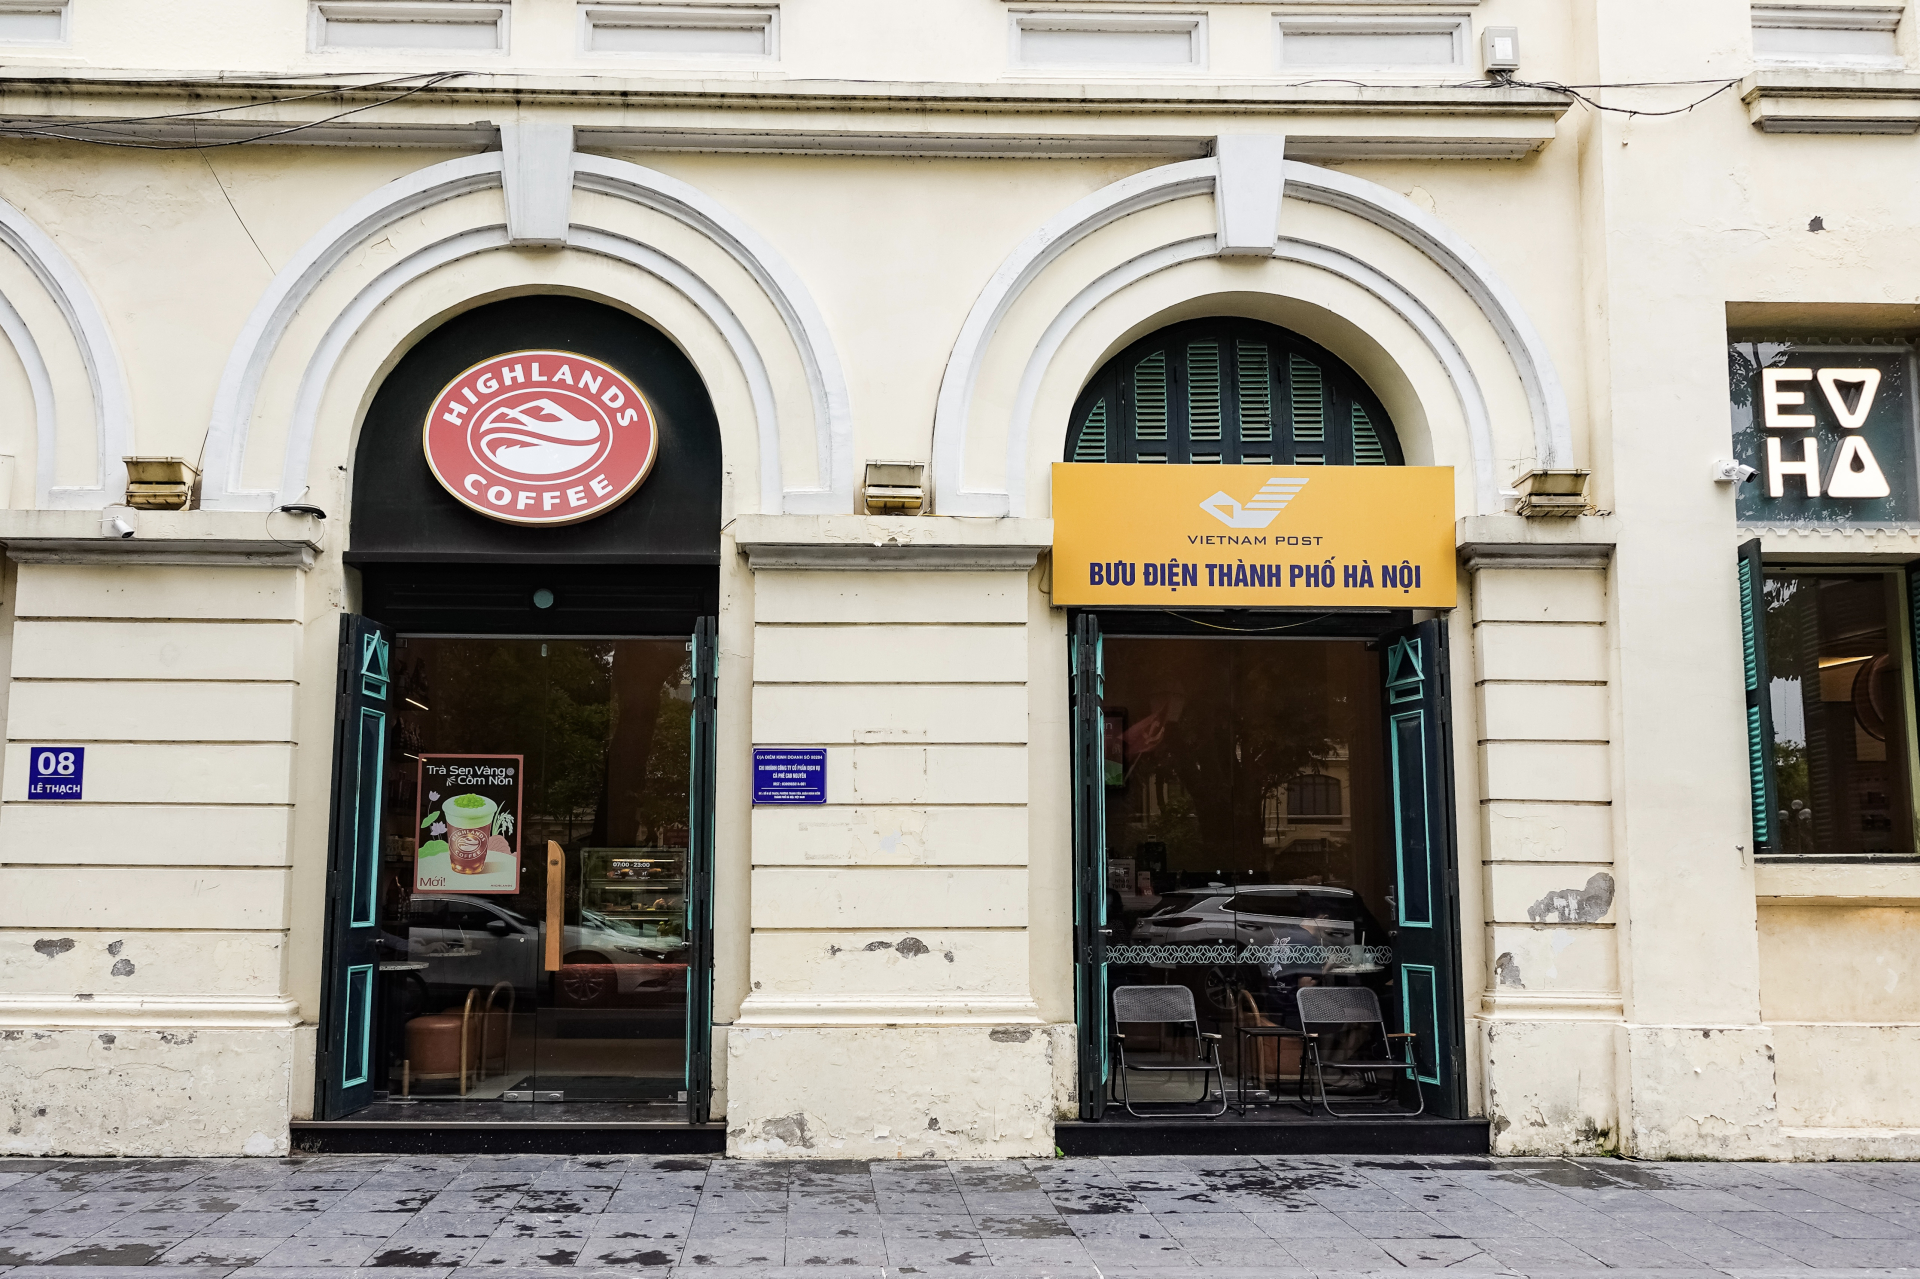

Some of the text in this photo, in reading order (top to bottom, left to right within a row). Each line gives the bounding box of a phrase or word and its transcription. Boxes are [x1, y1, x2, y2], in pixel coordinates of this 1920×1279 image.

[442, 362, 638, 427] HIGHLANDS
[463, 473, 614, 511] COFFEE
[1187, 535, 1324, 547] VIETNAM POST
[1089, 555, 1422, 594] BƯU ĐIỆN THÀNH PHỐ HÀ NỘI
[37, 751, 75, 775] 08
[426, 765, 506, 777] Trà Sen Vàng
[457, 774, 486, 785] Cốm
[31, 782, 81, 795] LÊ THẠCH
[419, 876, 446, 887] Mới!
